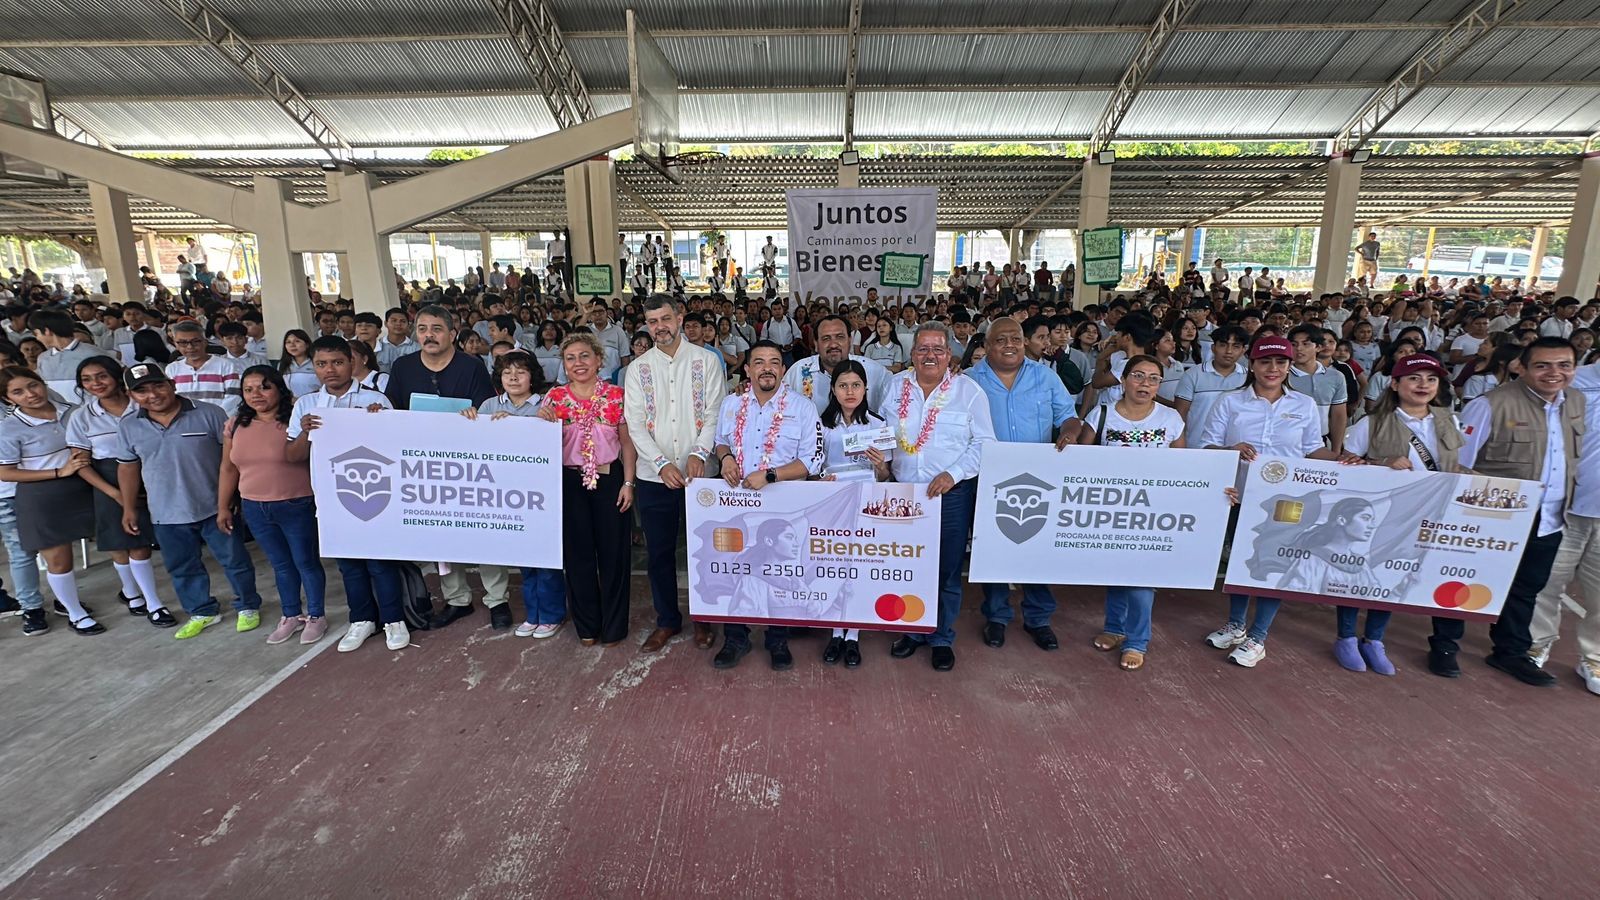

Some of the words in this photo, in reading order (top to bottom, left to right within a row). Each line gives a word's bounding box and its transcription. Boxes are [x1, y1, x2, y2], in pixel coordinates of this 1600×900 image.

[813, 202, 908, 230] Juntos
[807, 236, 876, 246] Caminamos
[881, 235, 902, 246] por
[907, 234, 917, 244] el
[855, 280, 868, 289] de
[402, 449, 427, 457] BECA
[428, 451, 480, 461] UNIVERSAL
[482, 453, 494, 461] DE
[496, 454, 549, 464] EDUCACIÓN
[1412, 438, 1430, 462] BIMBA
[400, 459, 495, 483] MEDIA
[1294, 467, 1328, 476] Gobierno
[1063, 476, 1088, 484] BECA
[1090, 477, 1140, 486] UNIVERSAL
[1142, 479, 1155, 487] DE
[1156, 478, 1210, 488] EDUCACIÓN
[1292, 472, 1338, 487] México
[400, 484, 545, 510] SUPERIOR
[718, 490, 752, 498] Gobierno
[1060, 486, 1151, 507] MEDIA
[719, 496, 761, 508] México
[403, 509, 452, 518] PROGRAMAS
[1057, 509, 1196, 532] SUPERIOR
[403, 518, 453, 527] BIENESTAR
[455, 520, 488, 529] BENITO
[490, 521, 525, 531] JUÁREZ
[1420, 519, 1458, 532] Banco
[1460, 523, 1480, 534] del
[809, 527, 850, 537] Banco
[855, 528, 875, 538] del
[1056, 532, 1100, 541] PROGRAMA
[809, 538, 925, 558] Bienestar
[1054, 541, 1102, 549] BIENESTAR
[1104, 542, 1136, 550] BENITO
[1138, 542, 1172, 552] JUÁREZ
[1416, 529, 1519, 552] Bienestar
[1277, 547, 1311, 560] 0000
[1330, 553, 1365, 566] 0000
[1385, 559, 1420, 573] 0000
[1440, 565, 1476, 579] 0000
[710, 562, 751, 575] 0123
[763, 564, 804, 577] 2350
[816, 566, 858, 579] 0660
[870, 568, 913, 582] 0880
[792, 591, 827, 601] 05/30
[1351, 584, 1391, 599] 00/00
